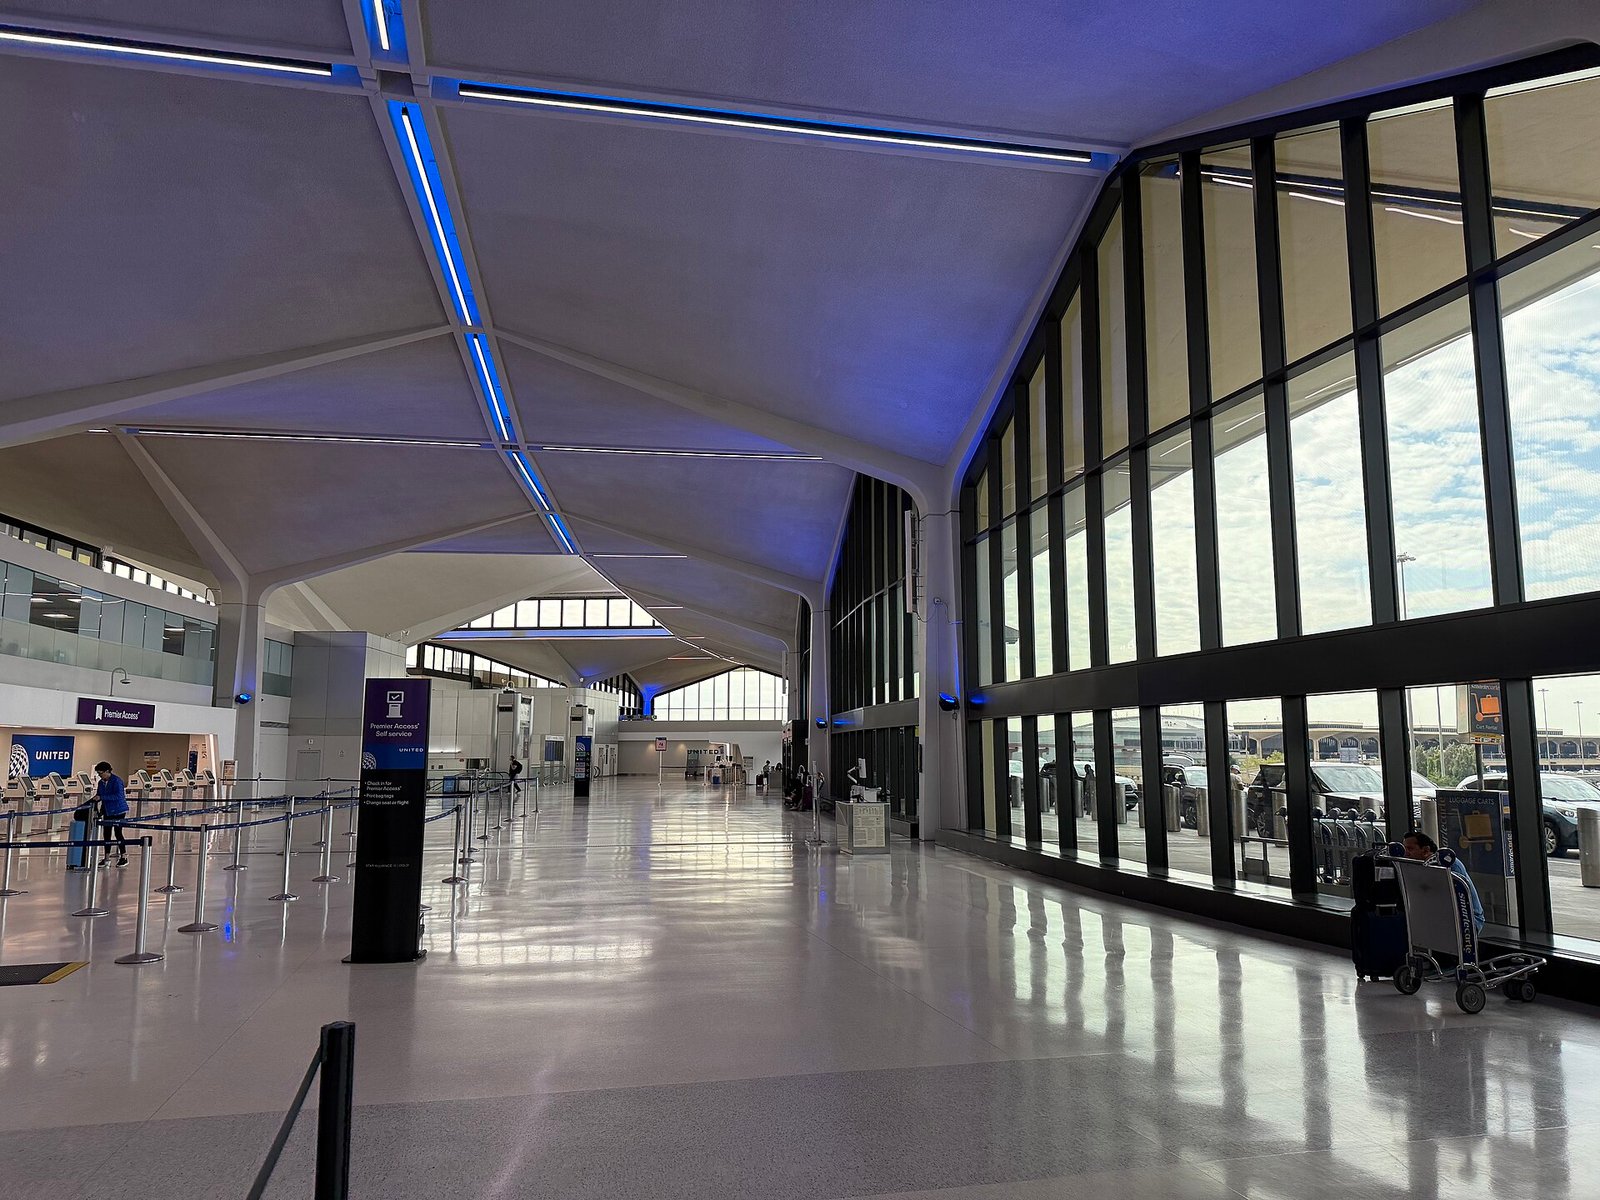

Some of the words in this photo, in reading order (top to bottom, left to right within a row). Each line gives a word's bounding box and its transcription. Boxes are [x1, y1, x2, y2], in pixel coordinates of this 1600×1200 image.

[104, 708, 122, 719] Premier
[35, 751, 70, 760] UNITED
[1449, 797, 1477, 805] LUGGAGE
[1478, 798, 1495, 806] CARTS
